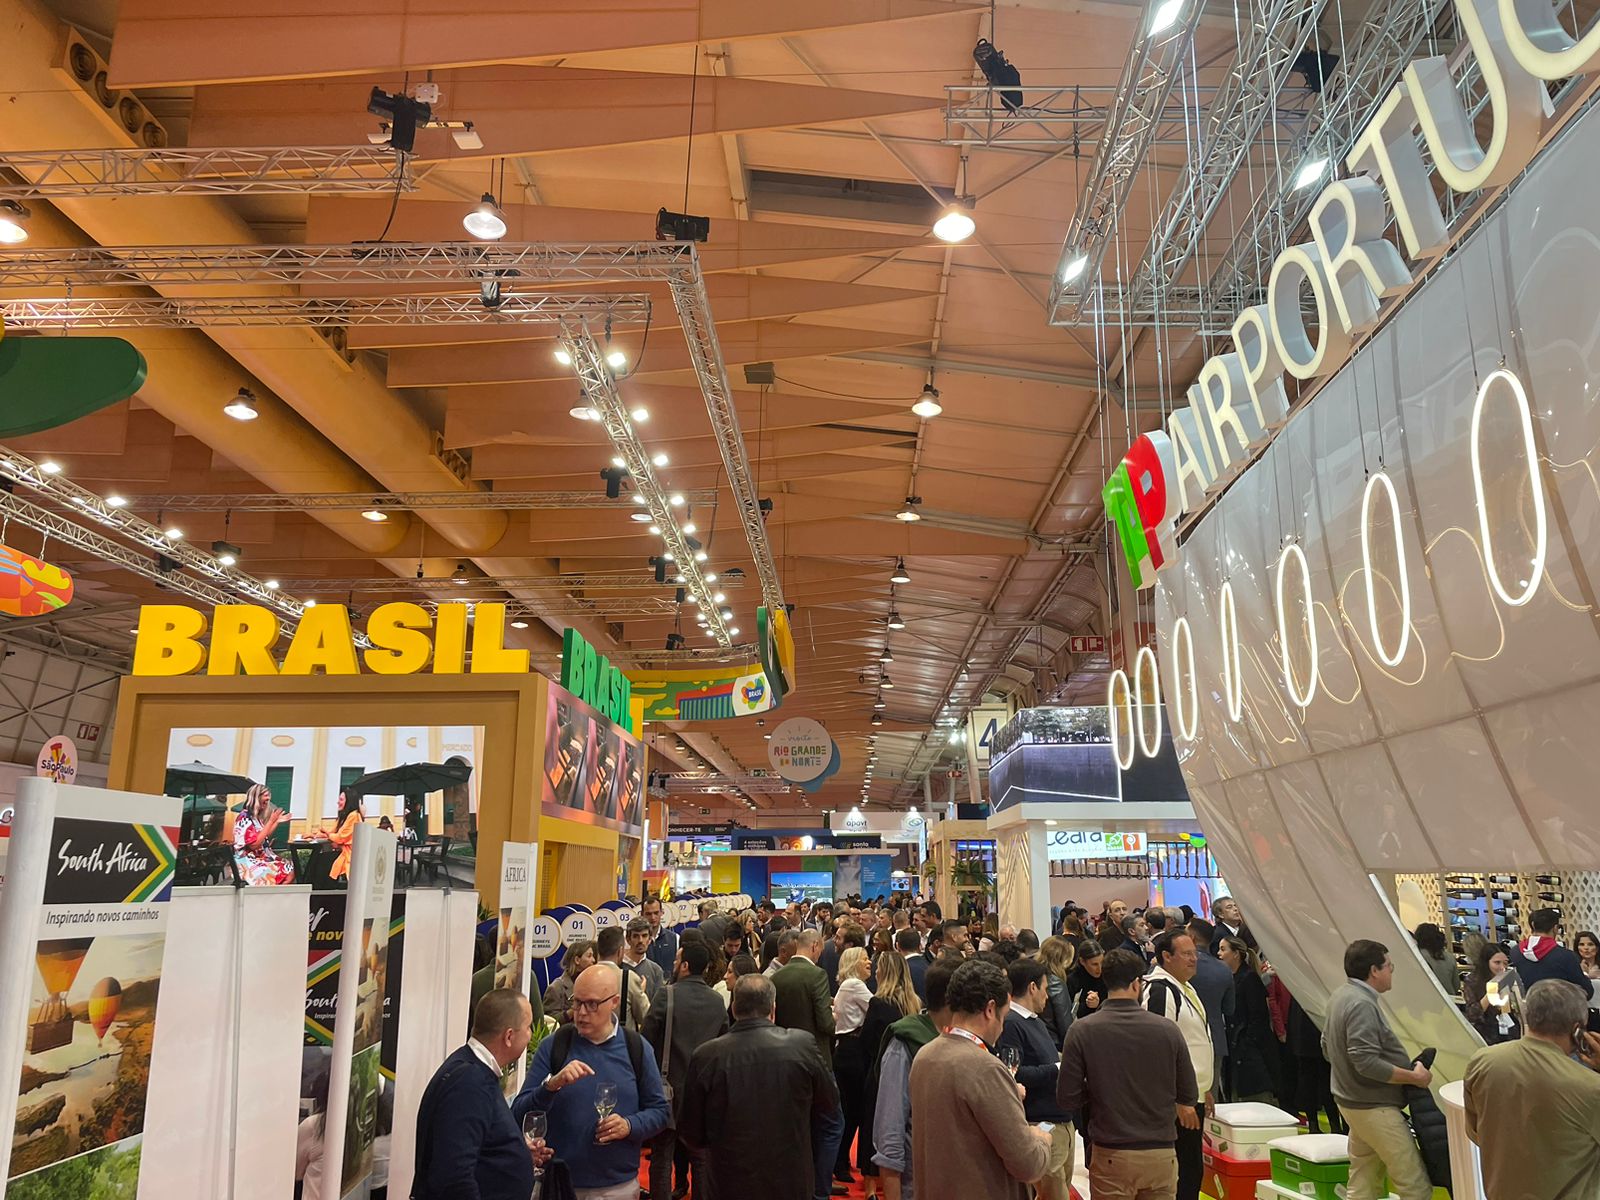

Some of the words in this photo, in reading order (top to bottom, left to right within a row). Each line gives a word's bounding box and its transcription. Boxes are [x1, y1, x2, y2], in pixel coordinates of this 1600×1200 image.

[132, 602, 530, 676] BRASIL
[561, 628, 633, 735] BRASIL
[748, 689, 762, 698] BRASIL
[979, 718, 998, 747] 4
[791, 745, 826, 756] GRANDE
[792, 756, 821, 766] NORTE
[57, 839, 103, 876] South
[105, 842, 148, 874] Africa
[504, 867, 526, 882] AFRICA
[46, 910, 95, 929] Inspirando
[97, 912, 121, 922] novos
[122, 908, 160, 921] caminhos
[597, 916, 608, 925] 02
[620, 913, 630, 922] 03
[534, 924, 547, 935] 01
[572, 920, 584, 930] 01
